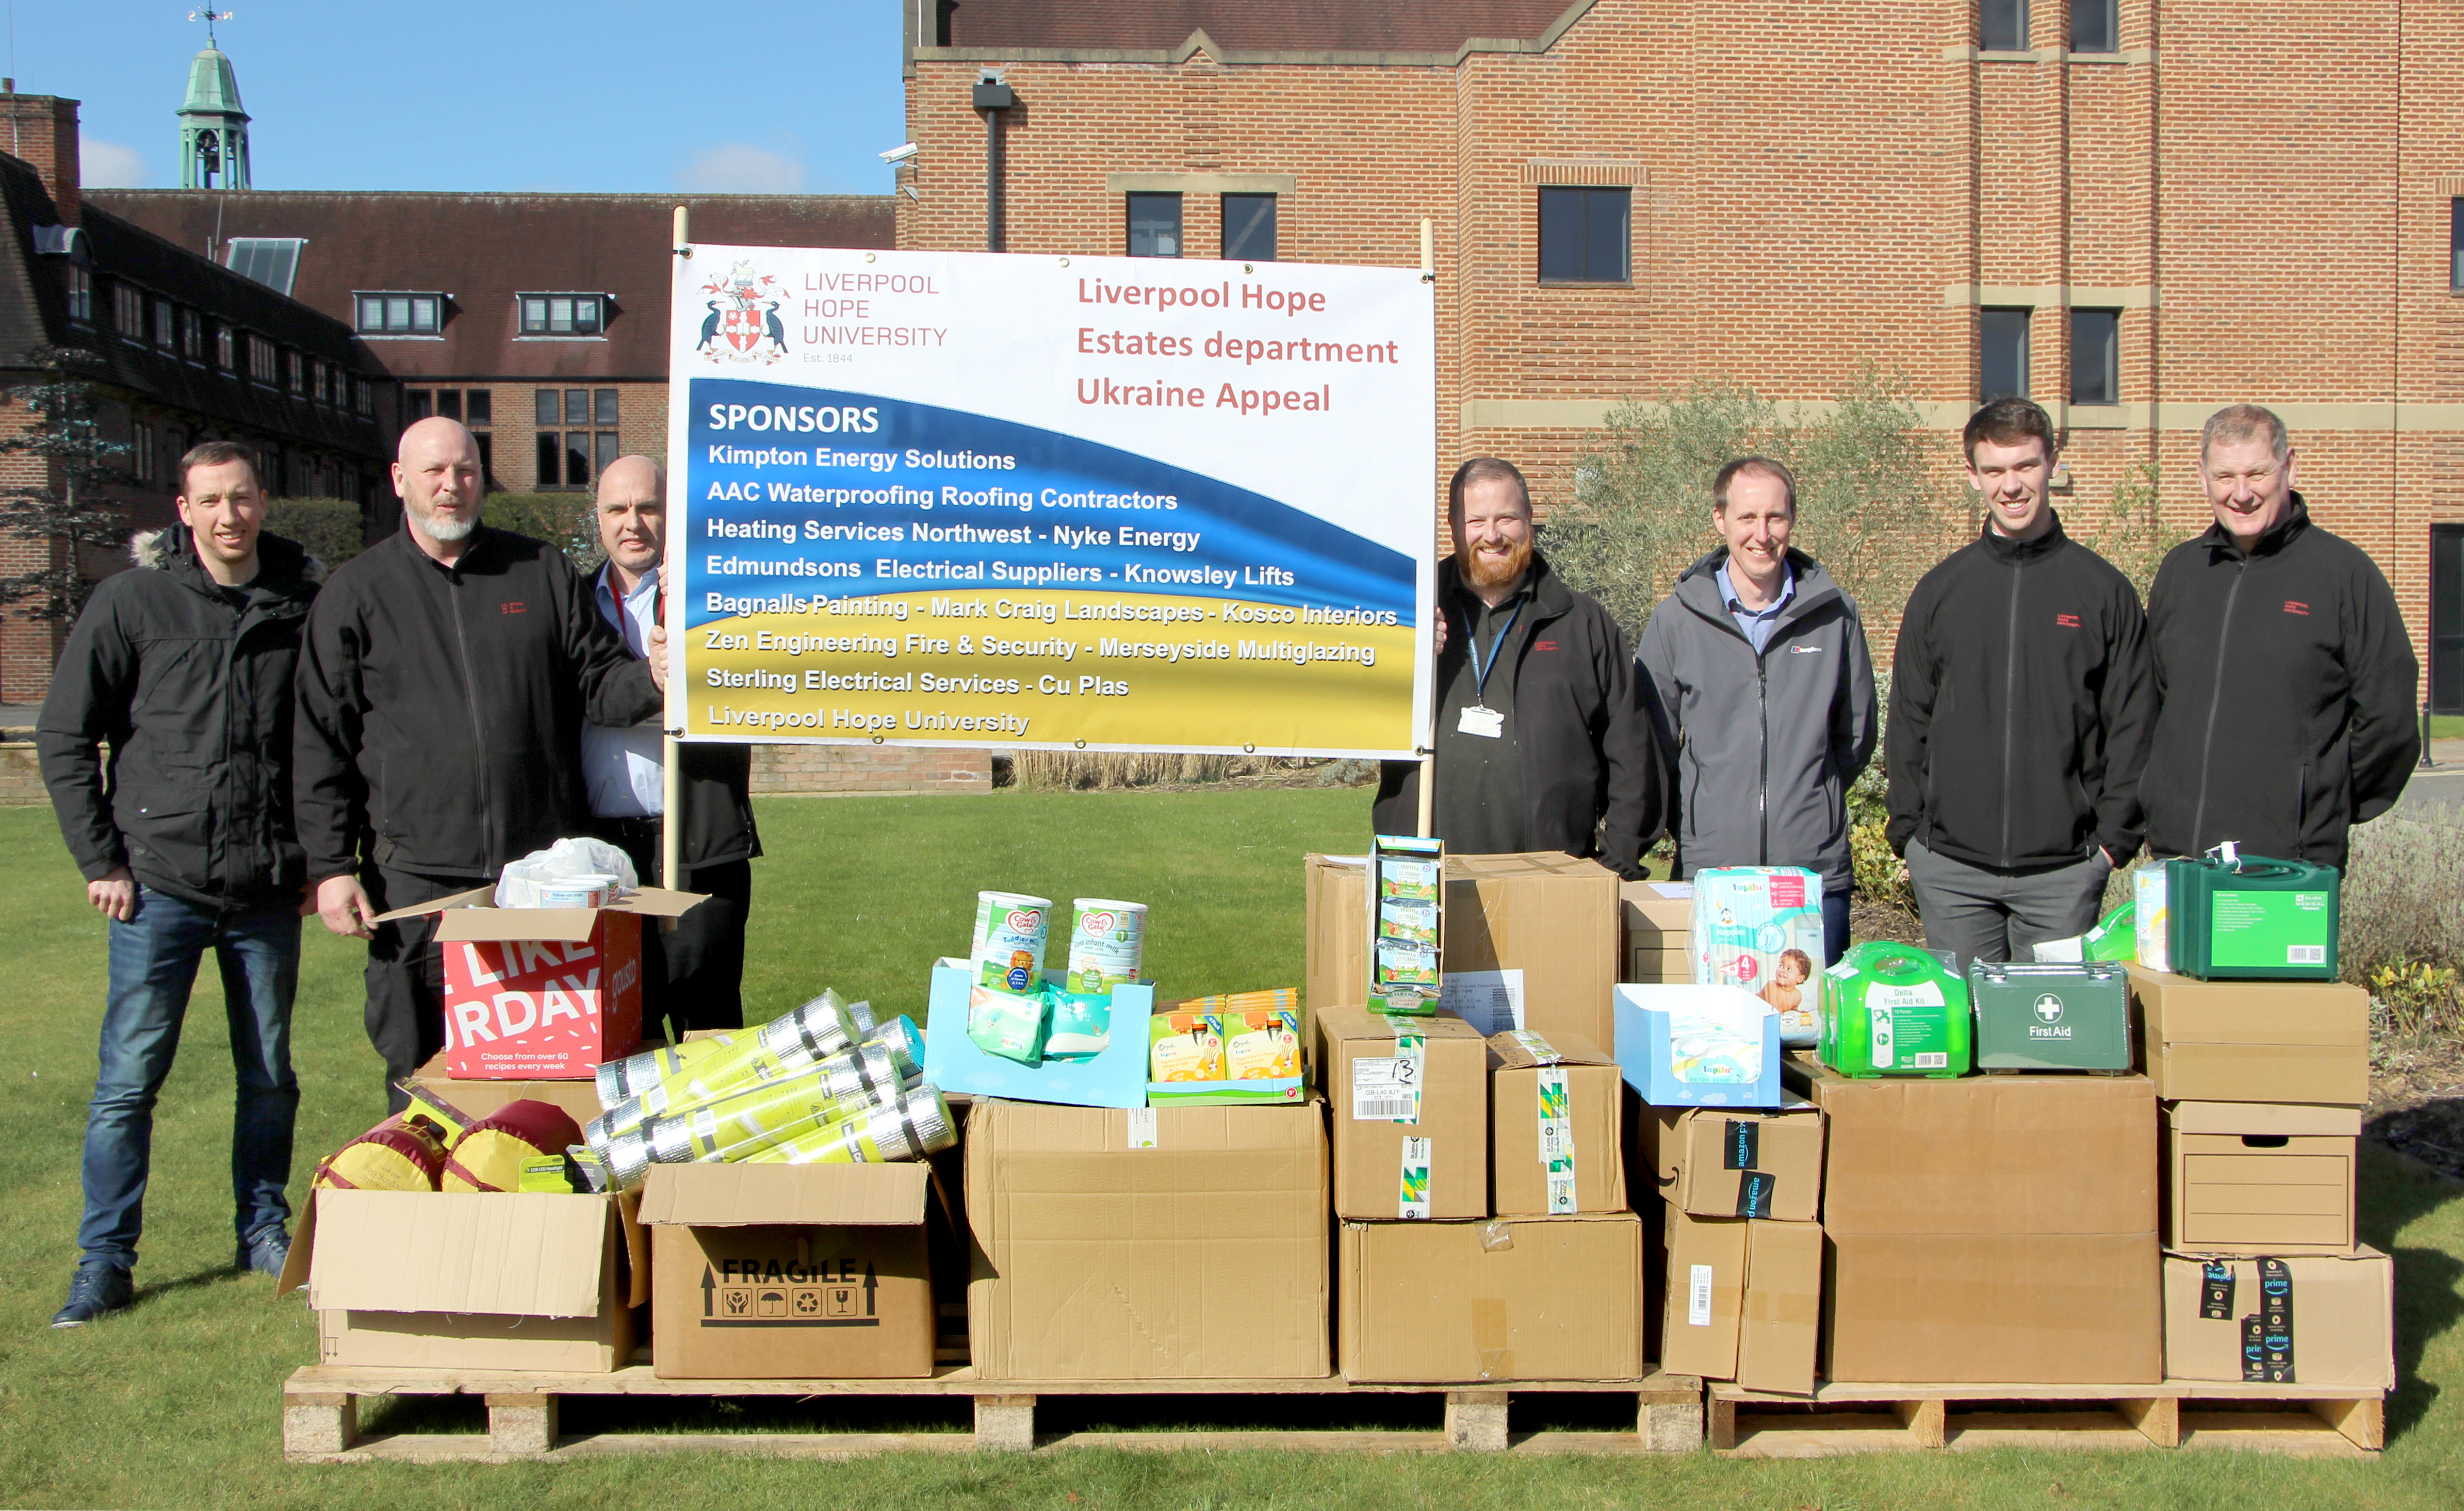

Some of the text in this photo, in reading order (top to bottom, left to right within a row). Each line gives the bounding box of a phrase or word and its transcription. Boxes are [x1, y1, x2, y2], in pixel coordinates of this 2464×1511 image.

[805, 272, 940, 294] LIVERPOOL
[804, 299, 870, 318] HOPE
[1079, 277, 1326, 317] Liverpool Hope
[803, 325, 948, 347] UNIVERSITY
[1078, 327, 1398, 365] Estates department
[803, 353, 853, 364] Est. 1844
[1078, 377, 1329, 416] Ukraine Appeal
[709, 404, 879, 433] SPONSORS
[709, 445, 1016, 472] Kimpton Energy Solutions
[707, 481, 1179, 512] AAC Waterproofing Roofing Contractors
[707, 518, 797, 544] Heating
[804, 520, 904, 542] Services
[912, 522, 1032, 545] Northwest
[1053, 524, 1112, 550] Nyke
[1118, 525, 1201, 552] Energy
[707, 555, 861, 577] Edmundsons
[876, 558, 984, 580] Electrical
[991, 560, 1103, 586] Suppliers
[1124, 563, 1237, 589] Knowsley
[1244, 565, 1295, 586] Lifts
[706, 592, 807, 618] Bagnalls
[812, 594, 909, 621] Painting
[931, 597, 988, 618] Mark
[994, 598, 1057, 624] Craig
[1064, 600, 1204, 626] Landscapes
[1222, 602, 1295, 623] Kosco
[1302, 604, 1398, 626] Interiors
[705, 630, 749, 650] Zen
[757, 631, 898, 657] Engineering
[905, 633, 950, 654] Fire
[956, 635, 974, 655] &
[981, 635, 1077, 662] Security
[1099, 637, 1231, 664] Merseyside
[1237, 639, 1376, 666] Multiglazing
[706, 668, 797, 694] Sterling
[804, 670, 912, 692] Electrical
[919, 672, 1020, 694] Services
[1038, 674, 1071, 695] Cu
[1079, 675, 1130, 696] Plas
[708, 705, 1031, 736] Liverpool Hope University
[1085, 939, 1105, 947] infant
[1741, 956, 1750, 970] 4
[2029, 1026, 2072, 1038] First Aid
[481, 1053, 514, 1061] Choose
[515, 1053, 536, 1061] from
[485, 1063, 517, 1071] recipes
[1703, 1065, 1732, 1075] lupilu
[2265, 1278, 2288, 1289] prime
[2265, 1334, 2289, 1344] prime
